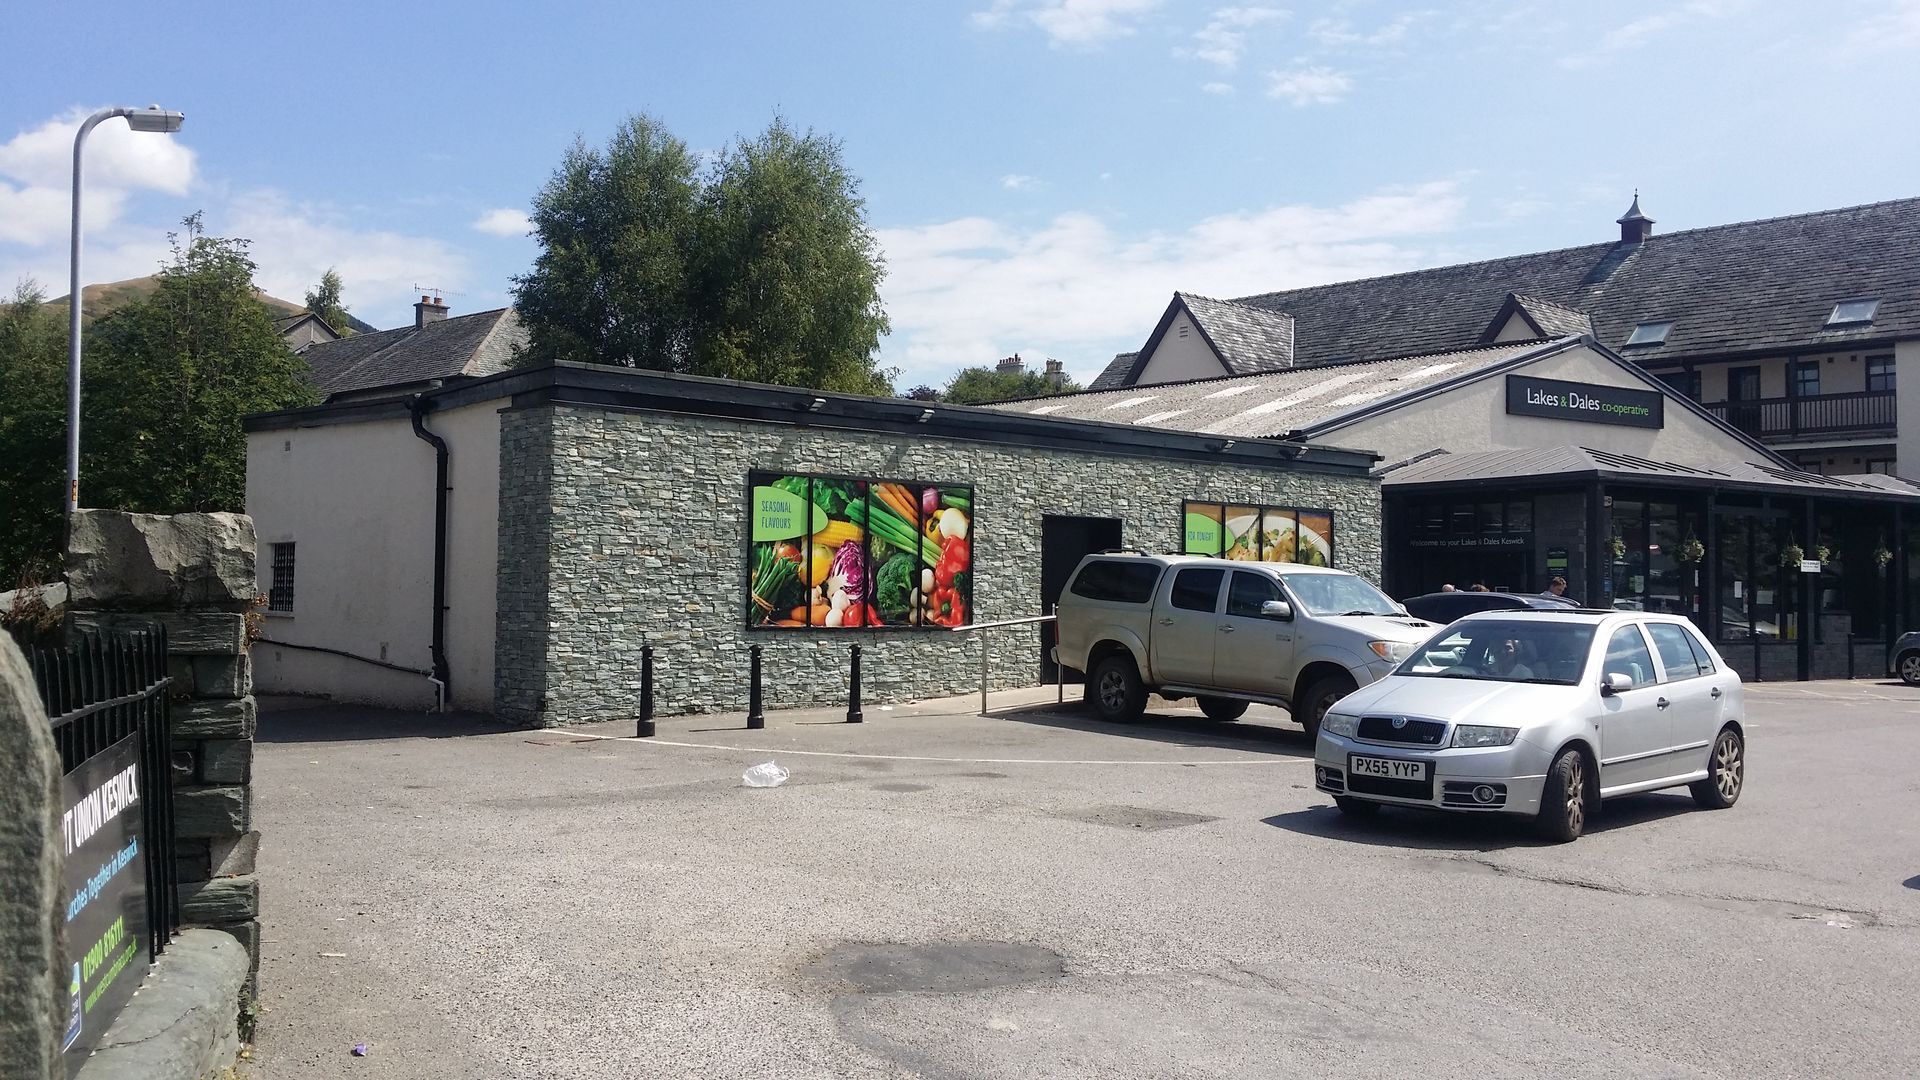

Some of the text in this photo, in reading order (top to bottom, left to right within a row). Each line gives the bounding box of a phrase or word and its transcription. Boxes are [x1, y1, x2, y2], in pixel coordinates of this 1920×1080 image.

[1527, 387, 1649, 417] Lakes & Dales co-operative
[761, 500, 792, 513] SEASONAL
[761, 516, 792, 529] FLAVOURS
[1188, 531, 1214, 542] FOR TONIGHT
[1410, 538, 1438, 546] Welcome
[1447, 540, 1460, 548] your
[1461, 537, 1477, 546] Lakes
[1484, 537, 1500, 546] Dales
[1501, 536, 1525, 545] Keswick
[1356, 758, 1420, 778] PX55 YYP
[63, 762, 138, 857] IT UNION KESWICK
[86, 863, 112, 900] Together
[110, 850, 118, 877] in
[116, 830, 138, 871] Keswick
[83, 938, 104, 984] 01900
